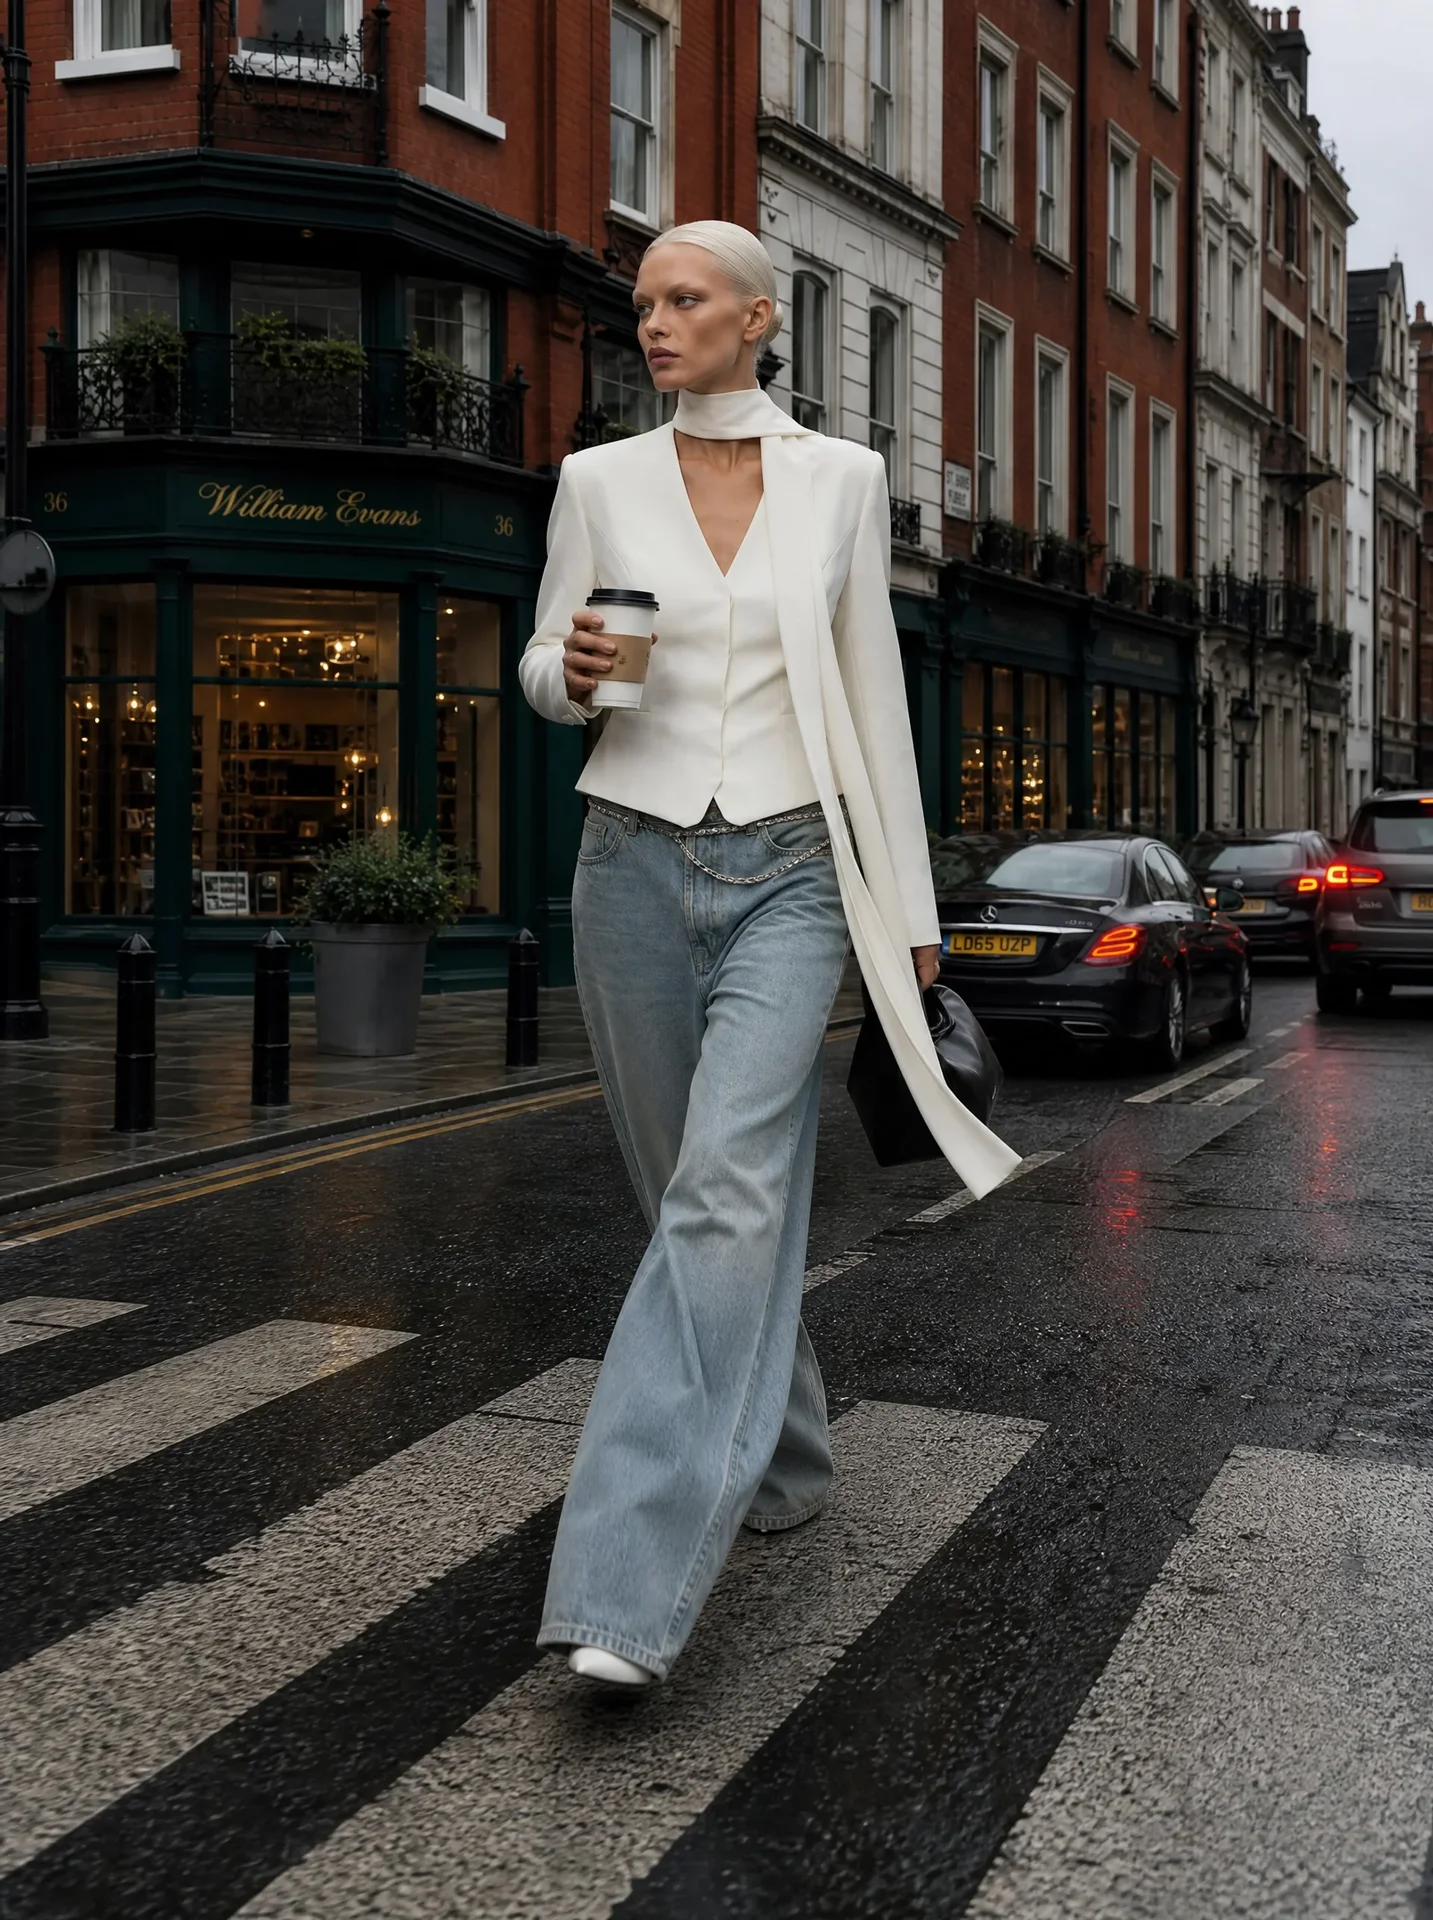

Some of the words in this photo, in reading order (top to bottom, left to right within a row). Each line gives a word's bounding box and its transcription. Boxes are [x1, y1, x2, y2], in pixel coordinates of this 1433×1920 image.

[43, 491, 69, 513] 36
[198, 482, 328, 522] William
[335, 489, 421, 526] Evans
[493, 514, 514, 537] 36
[953, 936, 995, 951] LD65
[1000, 937, 1031, 952] UZP
